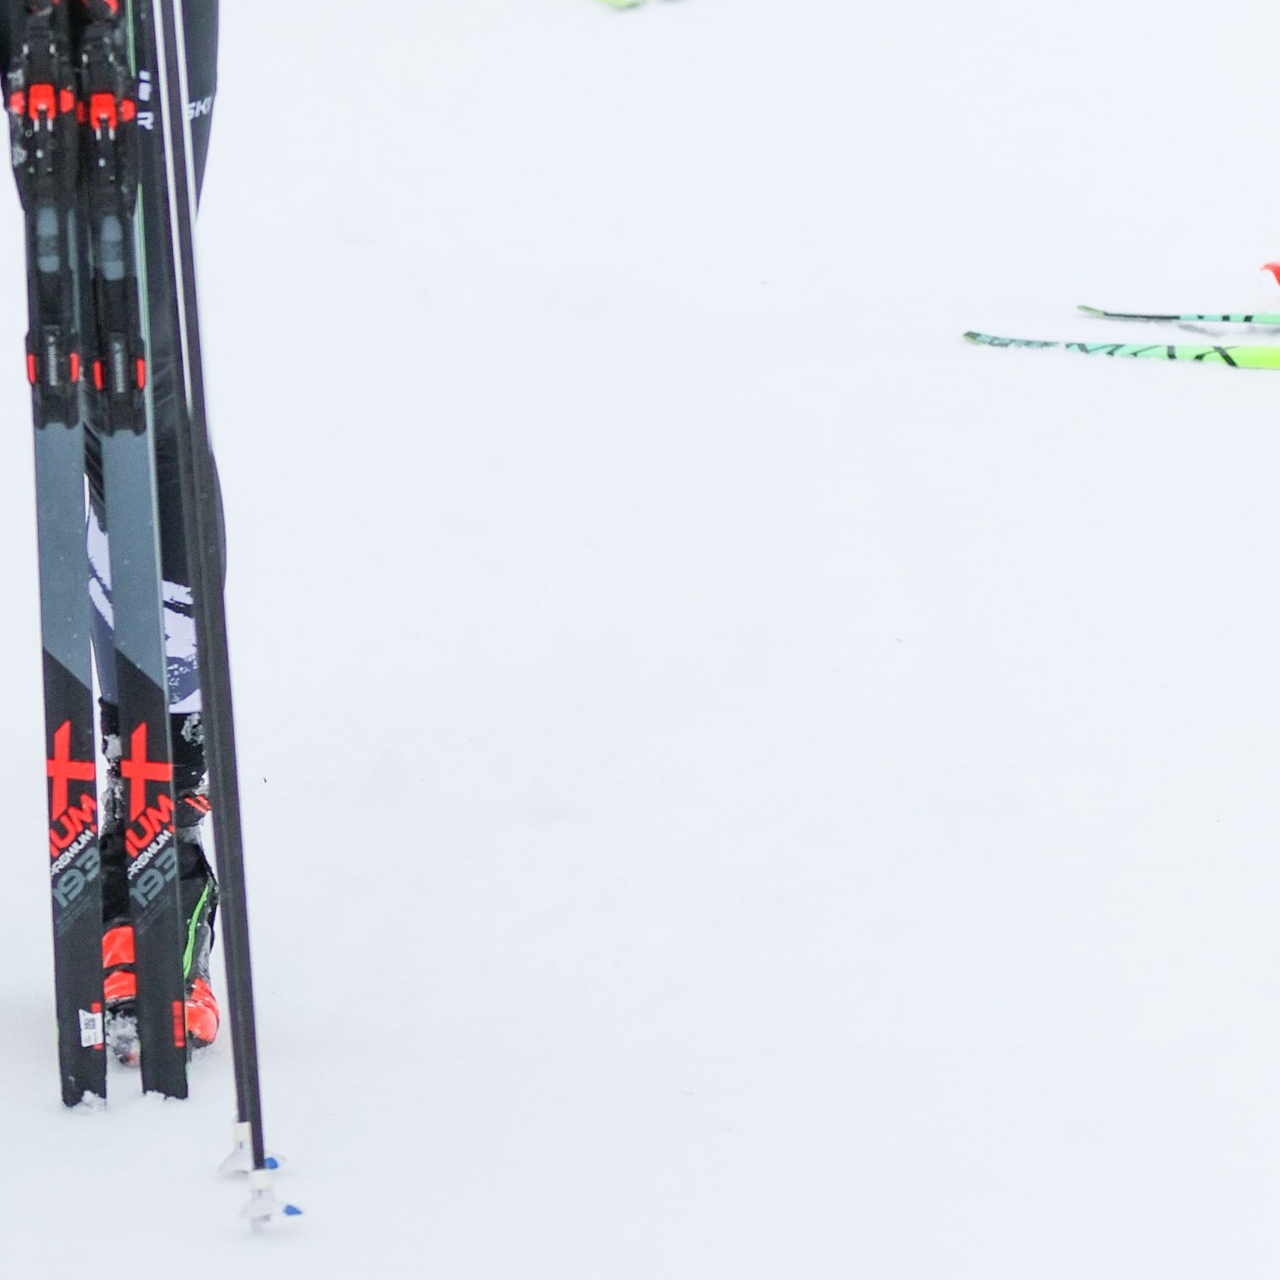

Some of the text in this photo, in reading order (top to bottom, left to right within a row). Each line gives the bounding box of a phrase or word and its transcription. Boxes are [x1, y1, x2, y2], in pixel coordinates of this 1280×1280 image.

[53, 846, 100, 908] 193
[128, 830, 172, 880] PREMIUM
[129, 847, 177, 907] 193
